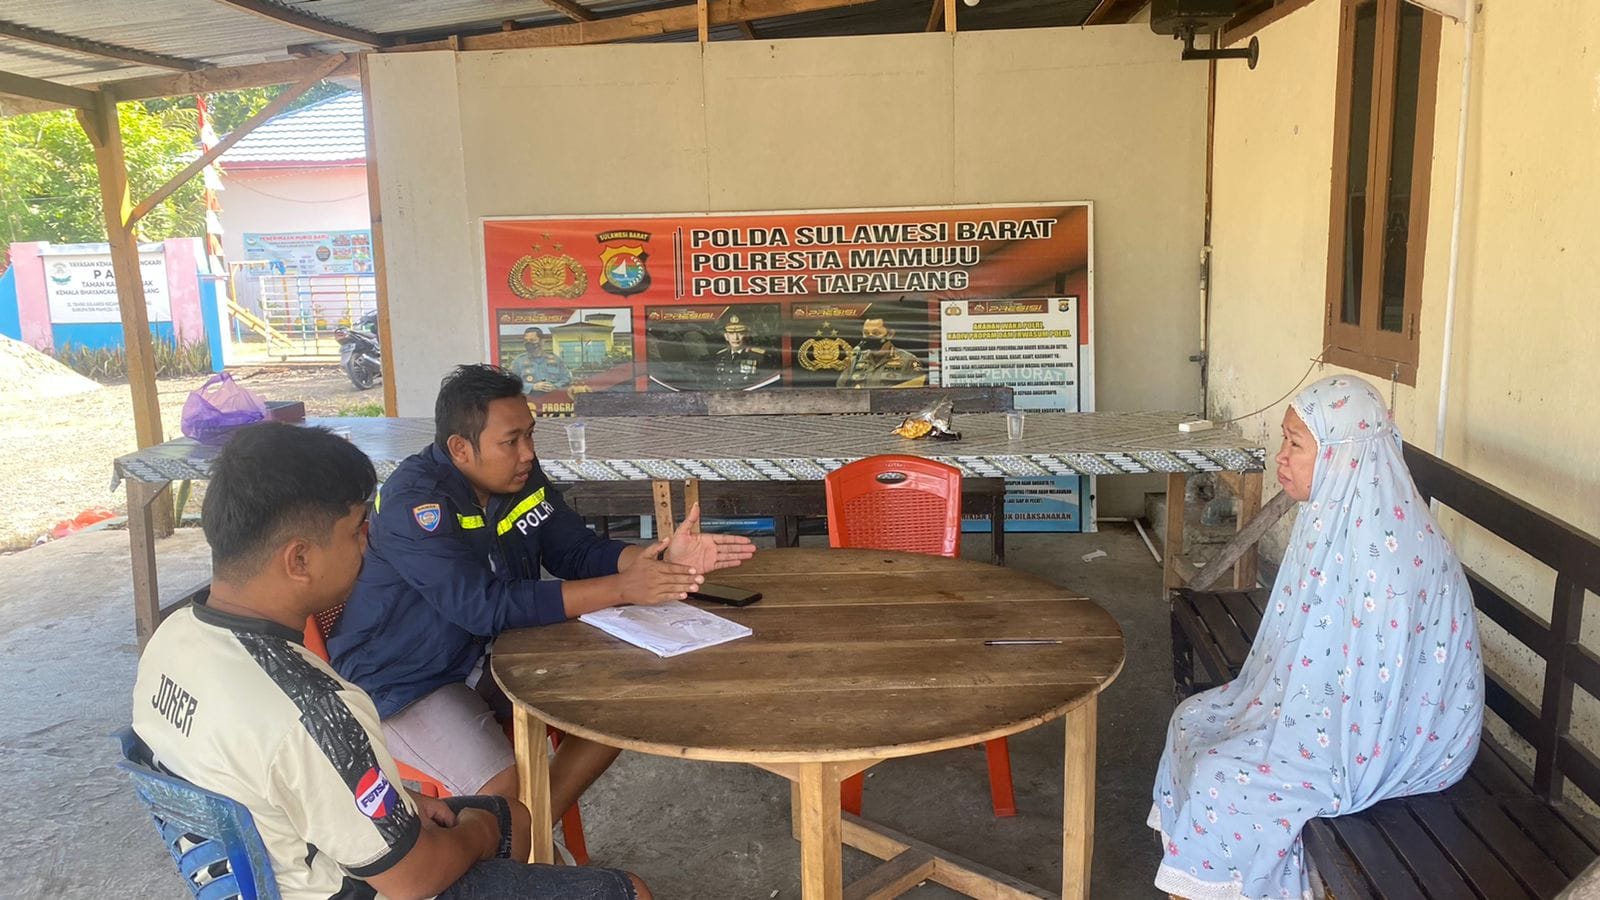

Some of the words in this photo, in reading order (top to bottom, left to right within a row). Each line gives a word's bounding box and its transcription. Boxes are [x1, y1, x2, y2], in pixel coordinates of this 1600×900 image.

[629, 231, 649, 240] BARAT
[691, 226, 788, 248] POLDA
[796, 222, 947, 246] SULAWESI
[956, 219, 1057, 242] BARAT
[692, 250, 843, 273] POLRESTA
[848, 246, 980, 268] MAMUJU
[692, 274, 808, 297] POLSEK
[814, 271, 968, 294] TAPALANG
[516, 500, 555, 535] POLRI
[152, 673, 198, 737] JOKER
